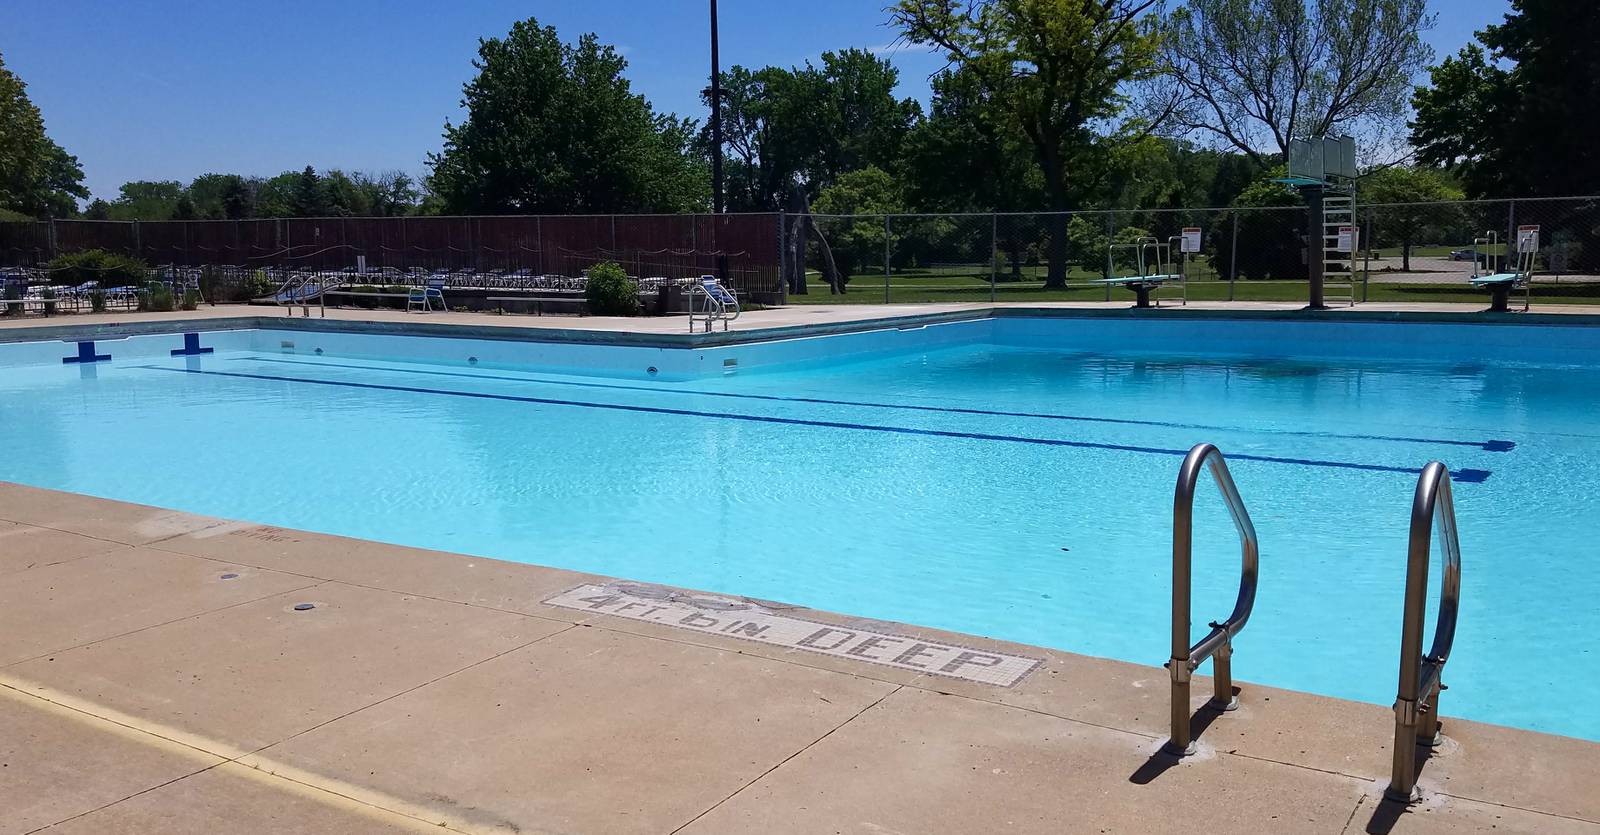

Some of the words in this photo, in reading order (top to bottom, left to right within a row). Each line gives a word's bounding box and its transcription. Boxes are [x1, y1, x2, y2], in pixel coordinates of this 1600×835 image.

[578, 595, 621, 609] 4
[720, 620, 771, 639] IN.
[796, 626, 1004, 673] DEEP
